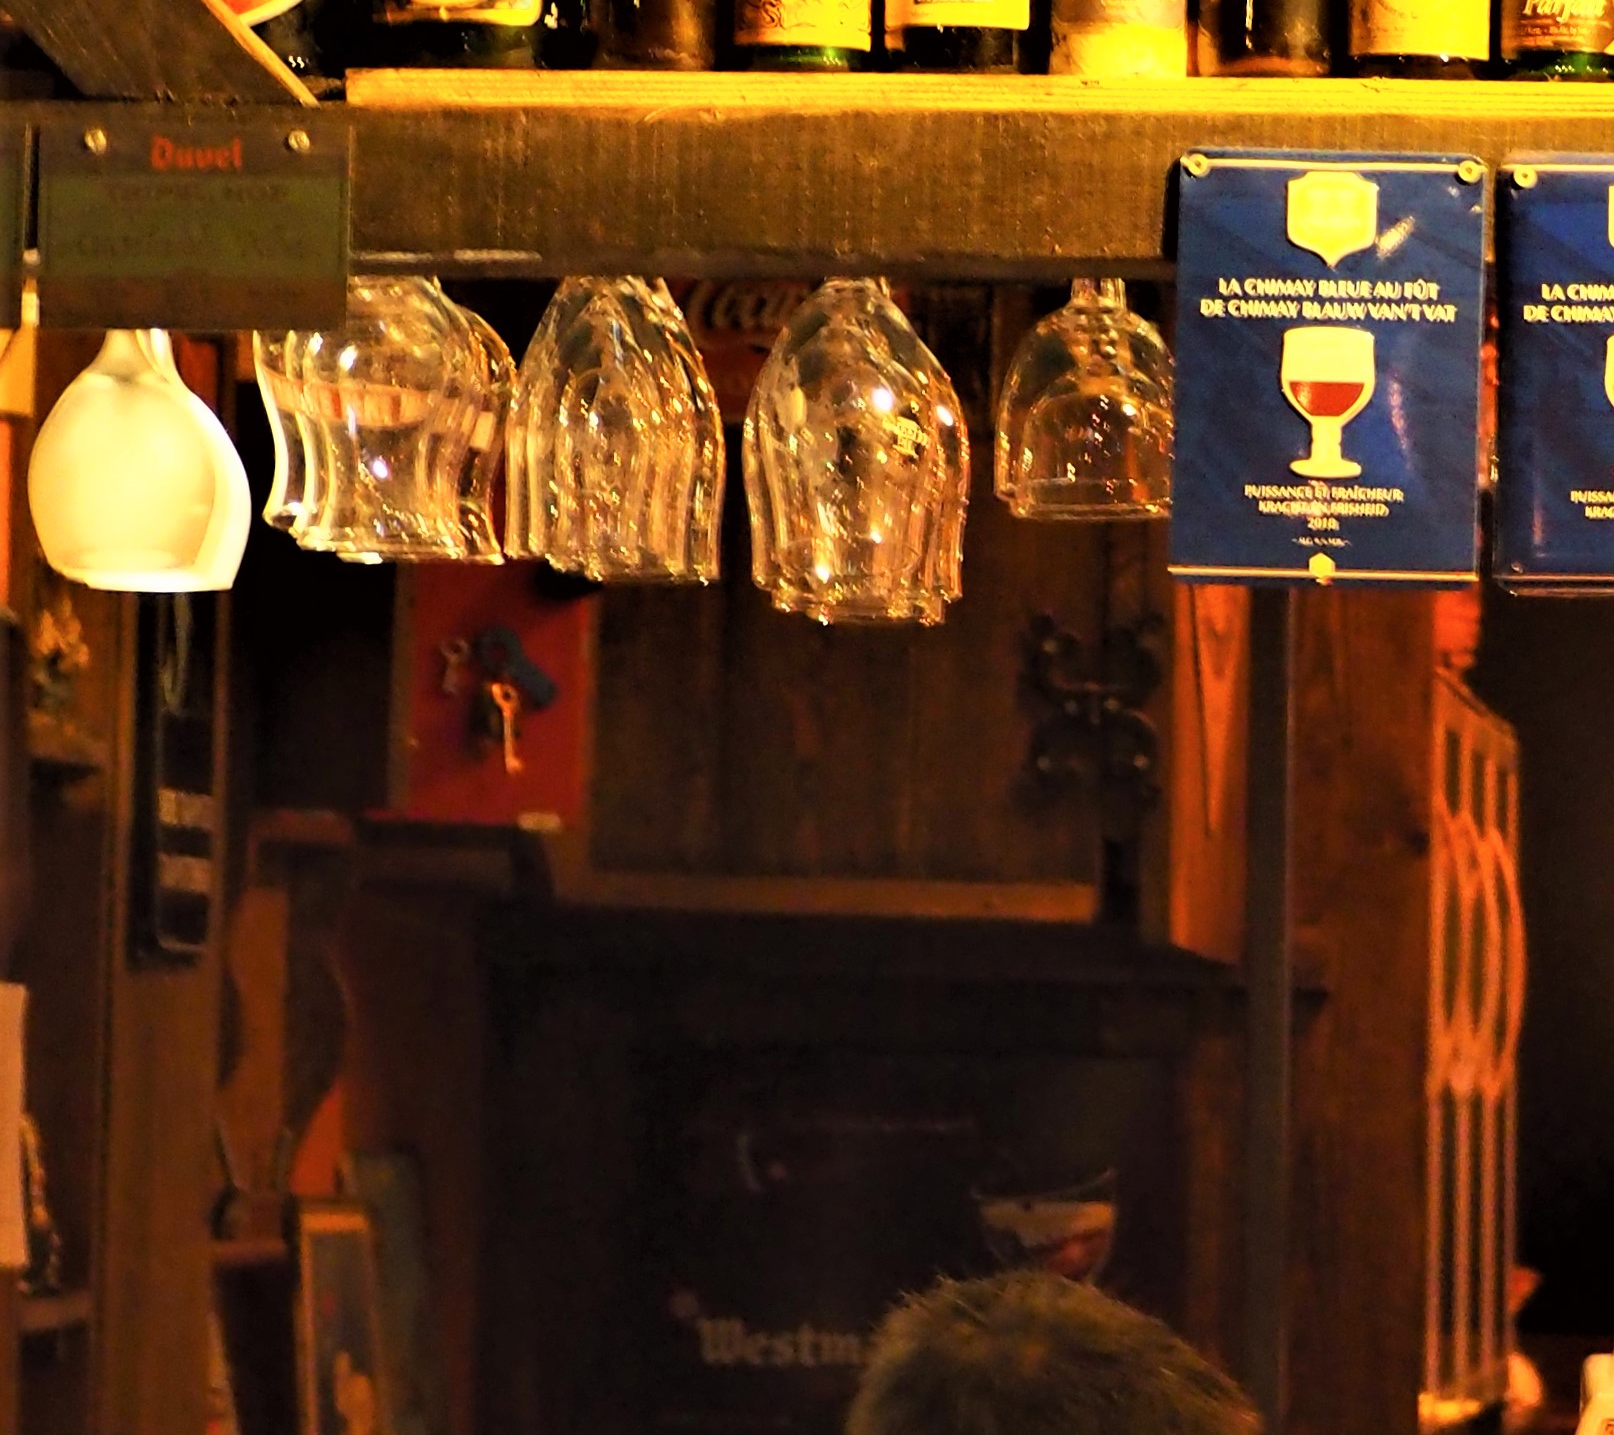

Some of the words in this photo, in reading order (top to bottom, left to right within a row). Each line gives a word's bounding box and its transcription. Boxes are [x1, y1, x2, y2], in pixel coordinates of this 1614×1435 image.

[151, 136, 243, 171] Duvel
[1218, 277, 1243, 297] LA
[1244, 277, 1316, 298] CHIMAY
[1318, 279, 1373, 299] BLEUE
[1374, 280, 1402, 300] AU
[1541, 283, 1566, 302] LA
[1200, 298, 1227, 318] DE
[1227, 299, 1300, 319] CHIMAY
[1302, 301, 1367, 320] BLAUW
[1423, 303, 1458, 323] VAT
[1523, 305, 1549, 323] DE
[696, 1316, 863, 1367] Westm
